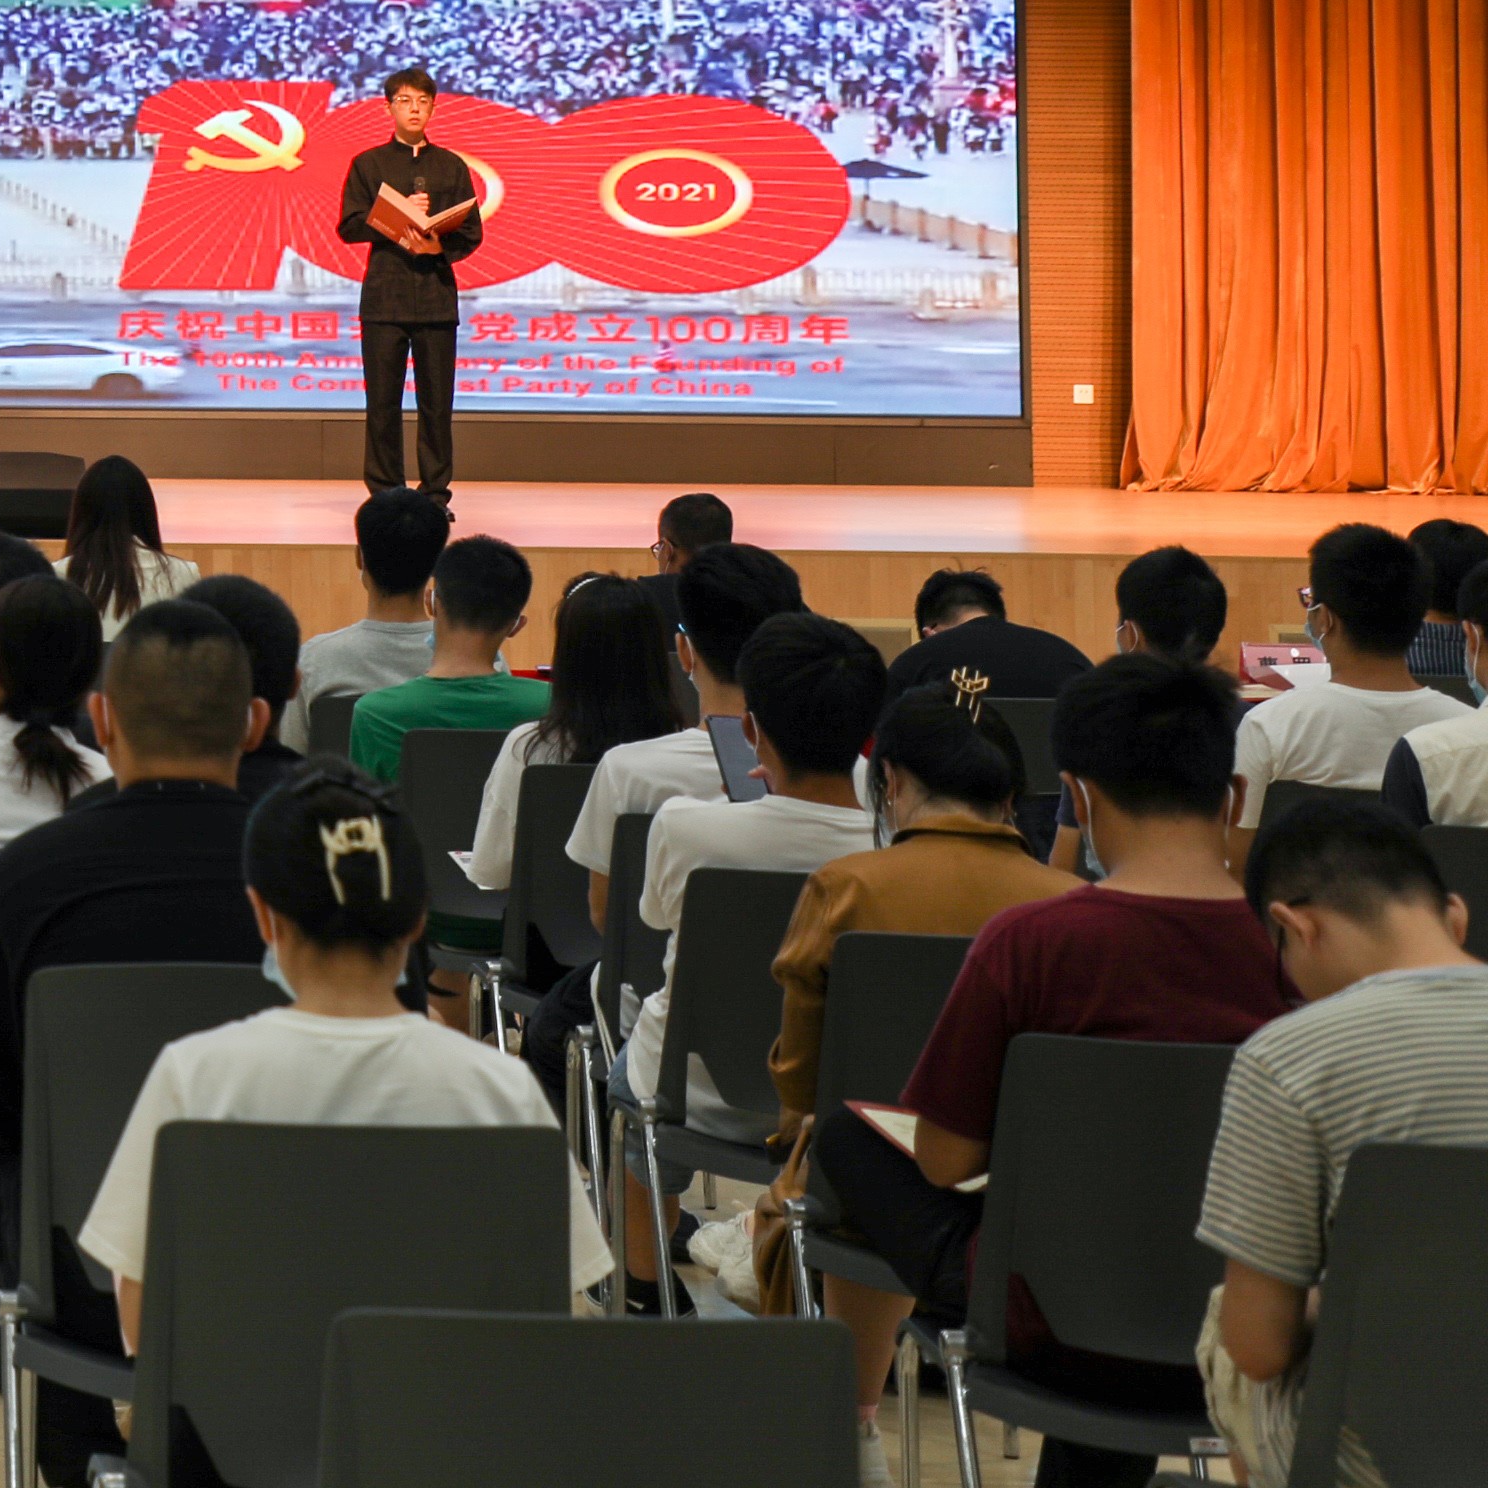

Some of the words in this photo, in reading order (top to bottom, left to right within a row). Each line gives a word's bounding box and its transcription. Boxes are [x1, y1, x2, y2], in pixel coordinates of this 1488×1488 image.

[635, 182, 716, 202] 2021
[117, 310, 849, 345] 庆祝中国党成立100周年
[120, 351, 179, 367] The
[517, 353, 552, 369] of
[563, 354, 616, 370] the
[811, 357, 844, 373] of
[217, 374, 280, 391] The
[503, 376, 593, 397] Party
[605, 378, 640, 394] of
[651, 378, 754, 396] China
